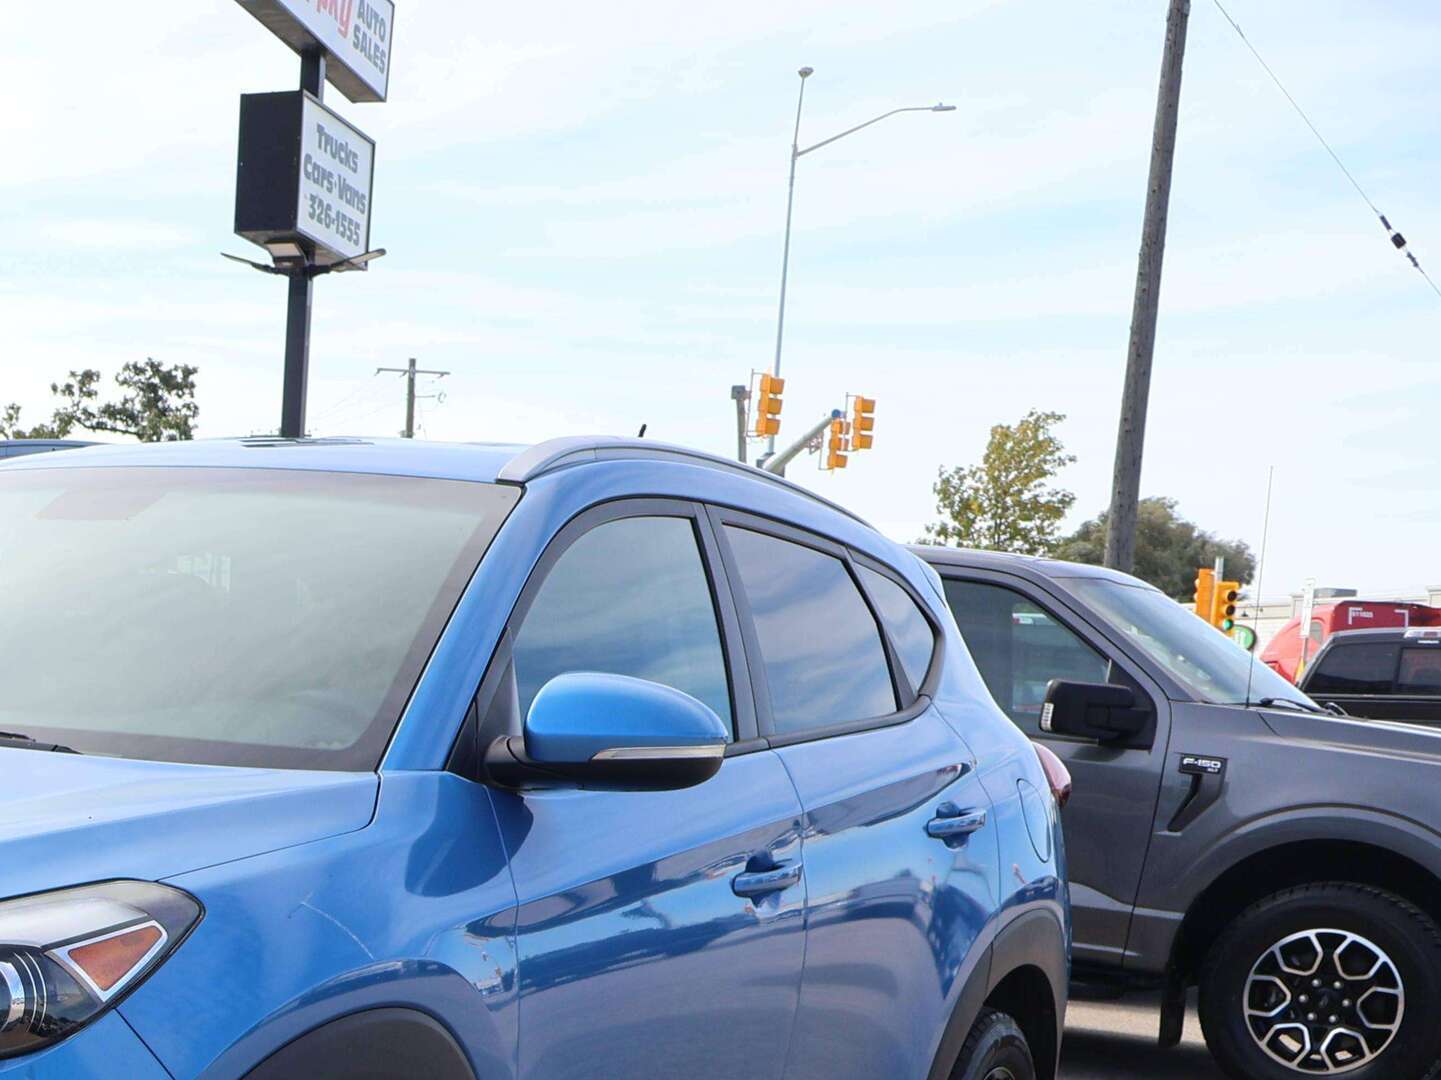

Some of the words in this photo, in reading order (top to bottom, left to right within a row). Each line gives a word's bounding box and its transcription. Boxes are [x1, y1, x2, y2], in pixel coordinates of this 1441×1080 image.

[357, 0, 386, 42] AUTO
[353, 23, 386, 74] SALES
[317, 123, 359, 173] Trucks
[308, 193, 361, 247] 326-1555
[1183, 757, 1221, 768] F-150
